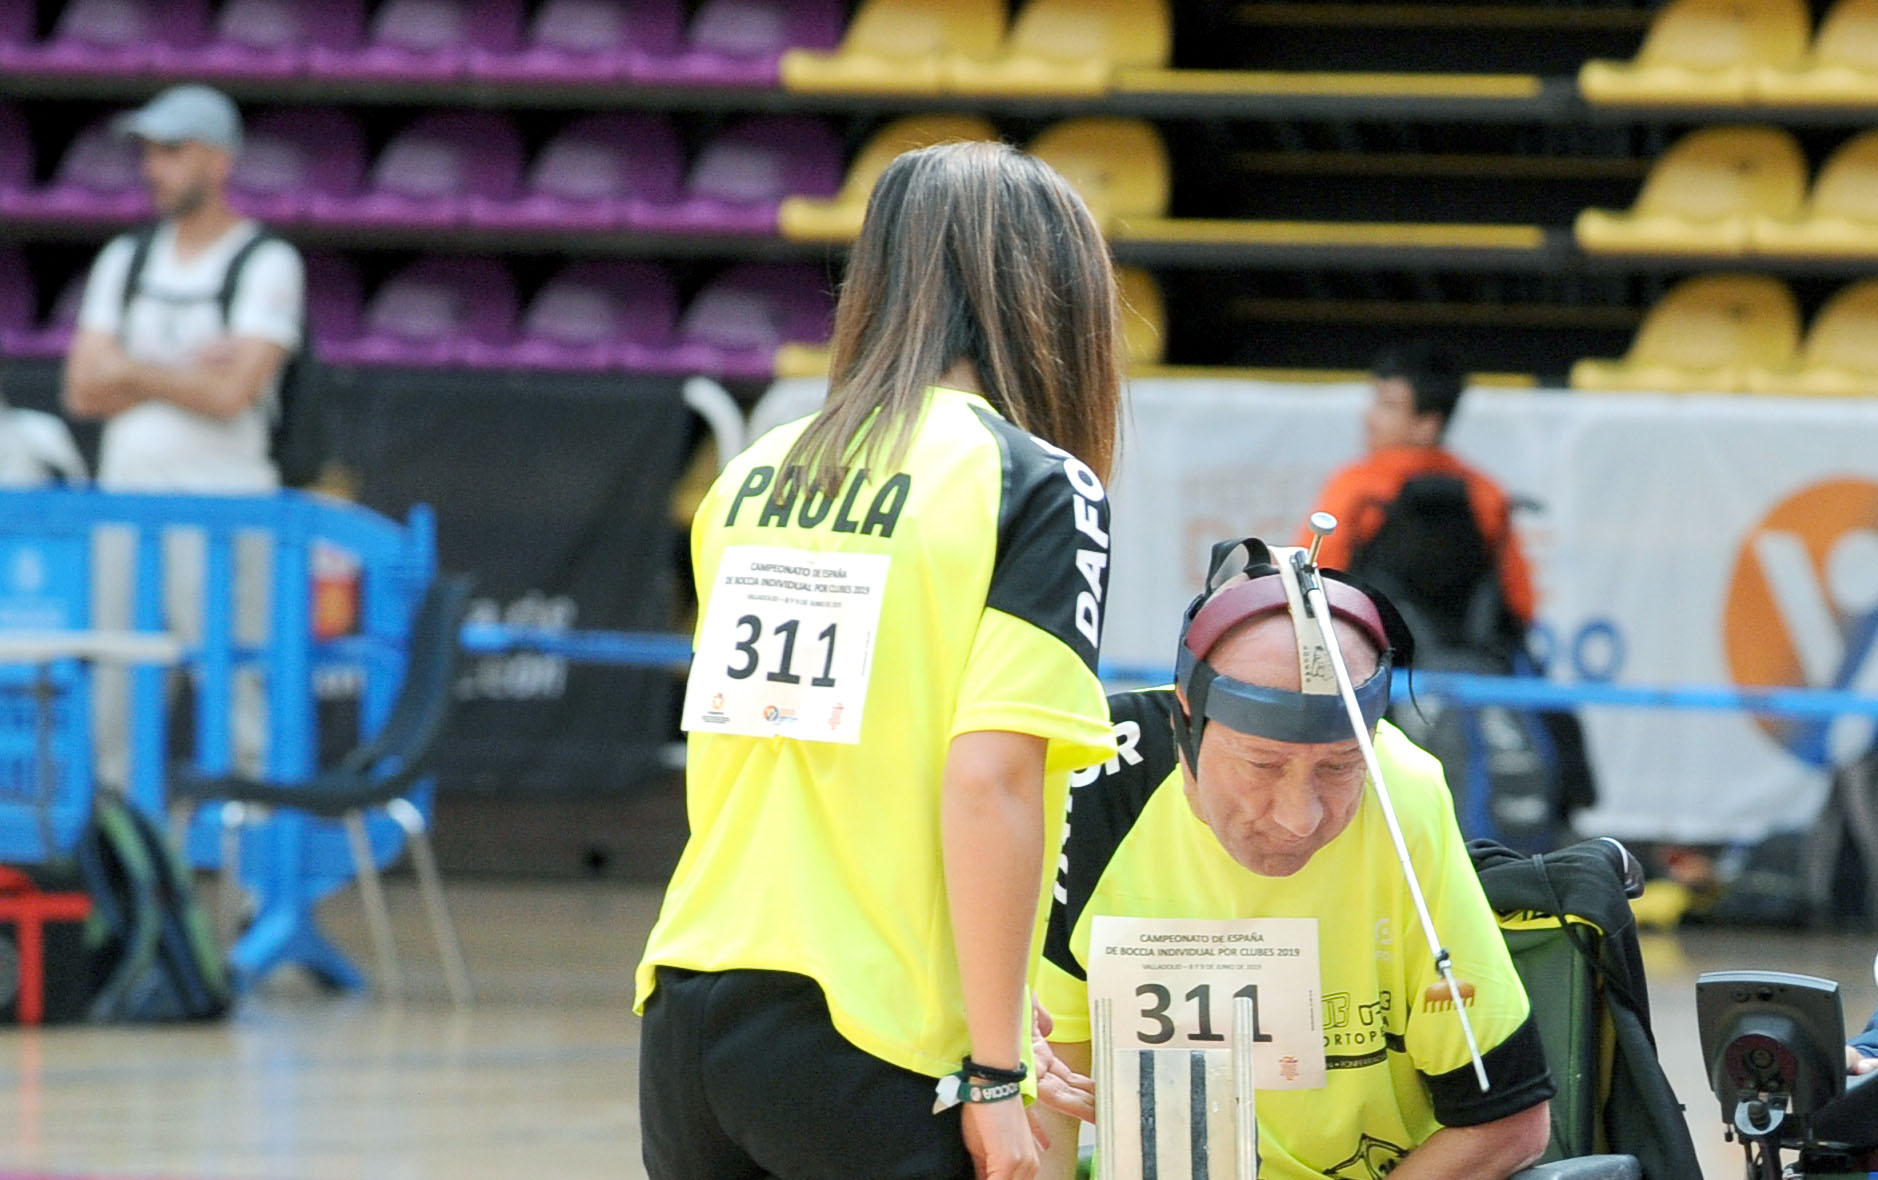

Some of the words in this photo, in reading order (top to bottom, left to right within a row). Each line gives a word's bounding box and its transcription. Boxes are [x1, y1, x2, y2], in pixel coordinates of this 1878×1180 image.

[724, 465, 911, 538] PAULA
[1030, 436, 1109, 649] DAFO
[726, 614, 838, 688] 311
[1105, 946, 1118, 955] DE
[1120, 947, 1155, 956] BOCCIA
[1157, 948, 1216, 957] INDIVIDUAL
[1217, 948, 1238, 957] POR
[1239, 948, 1275, 957] CLUBES
[1277, 948, 1300, 957] 2019
[1140, 934, 1210, 943] CAMPEONATO
[1211, 935, 1225, 944] DE
[1227, 932, 1264, 943] ESPAÑA
[1135, 983, 1273, 1045] 311
[1322, 1027, 1385, 1048] ORTOP
